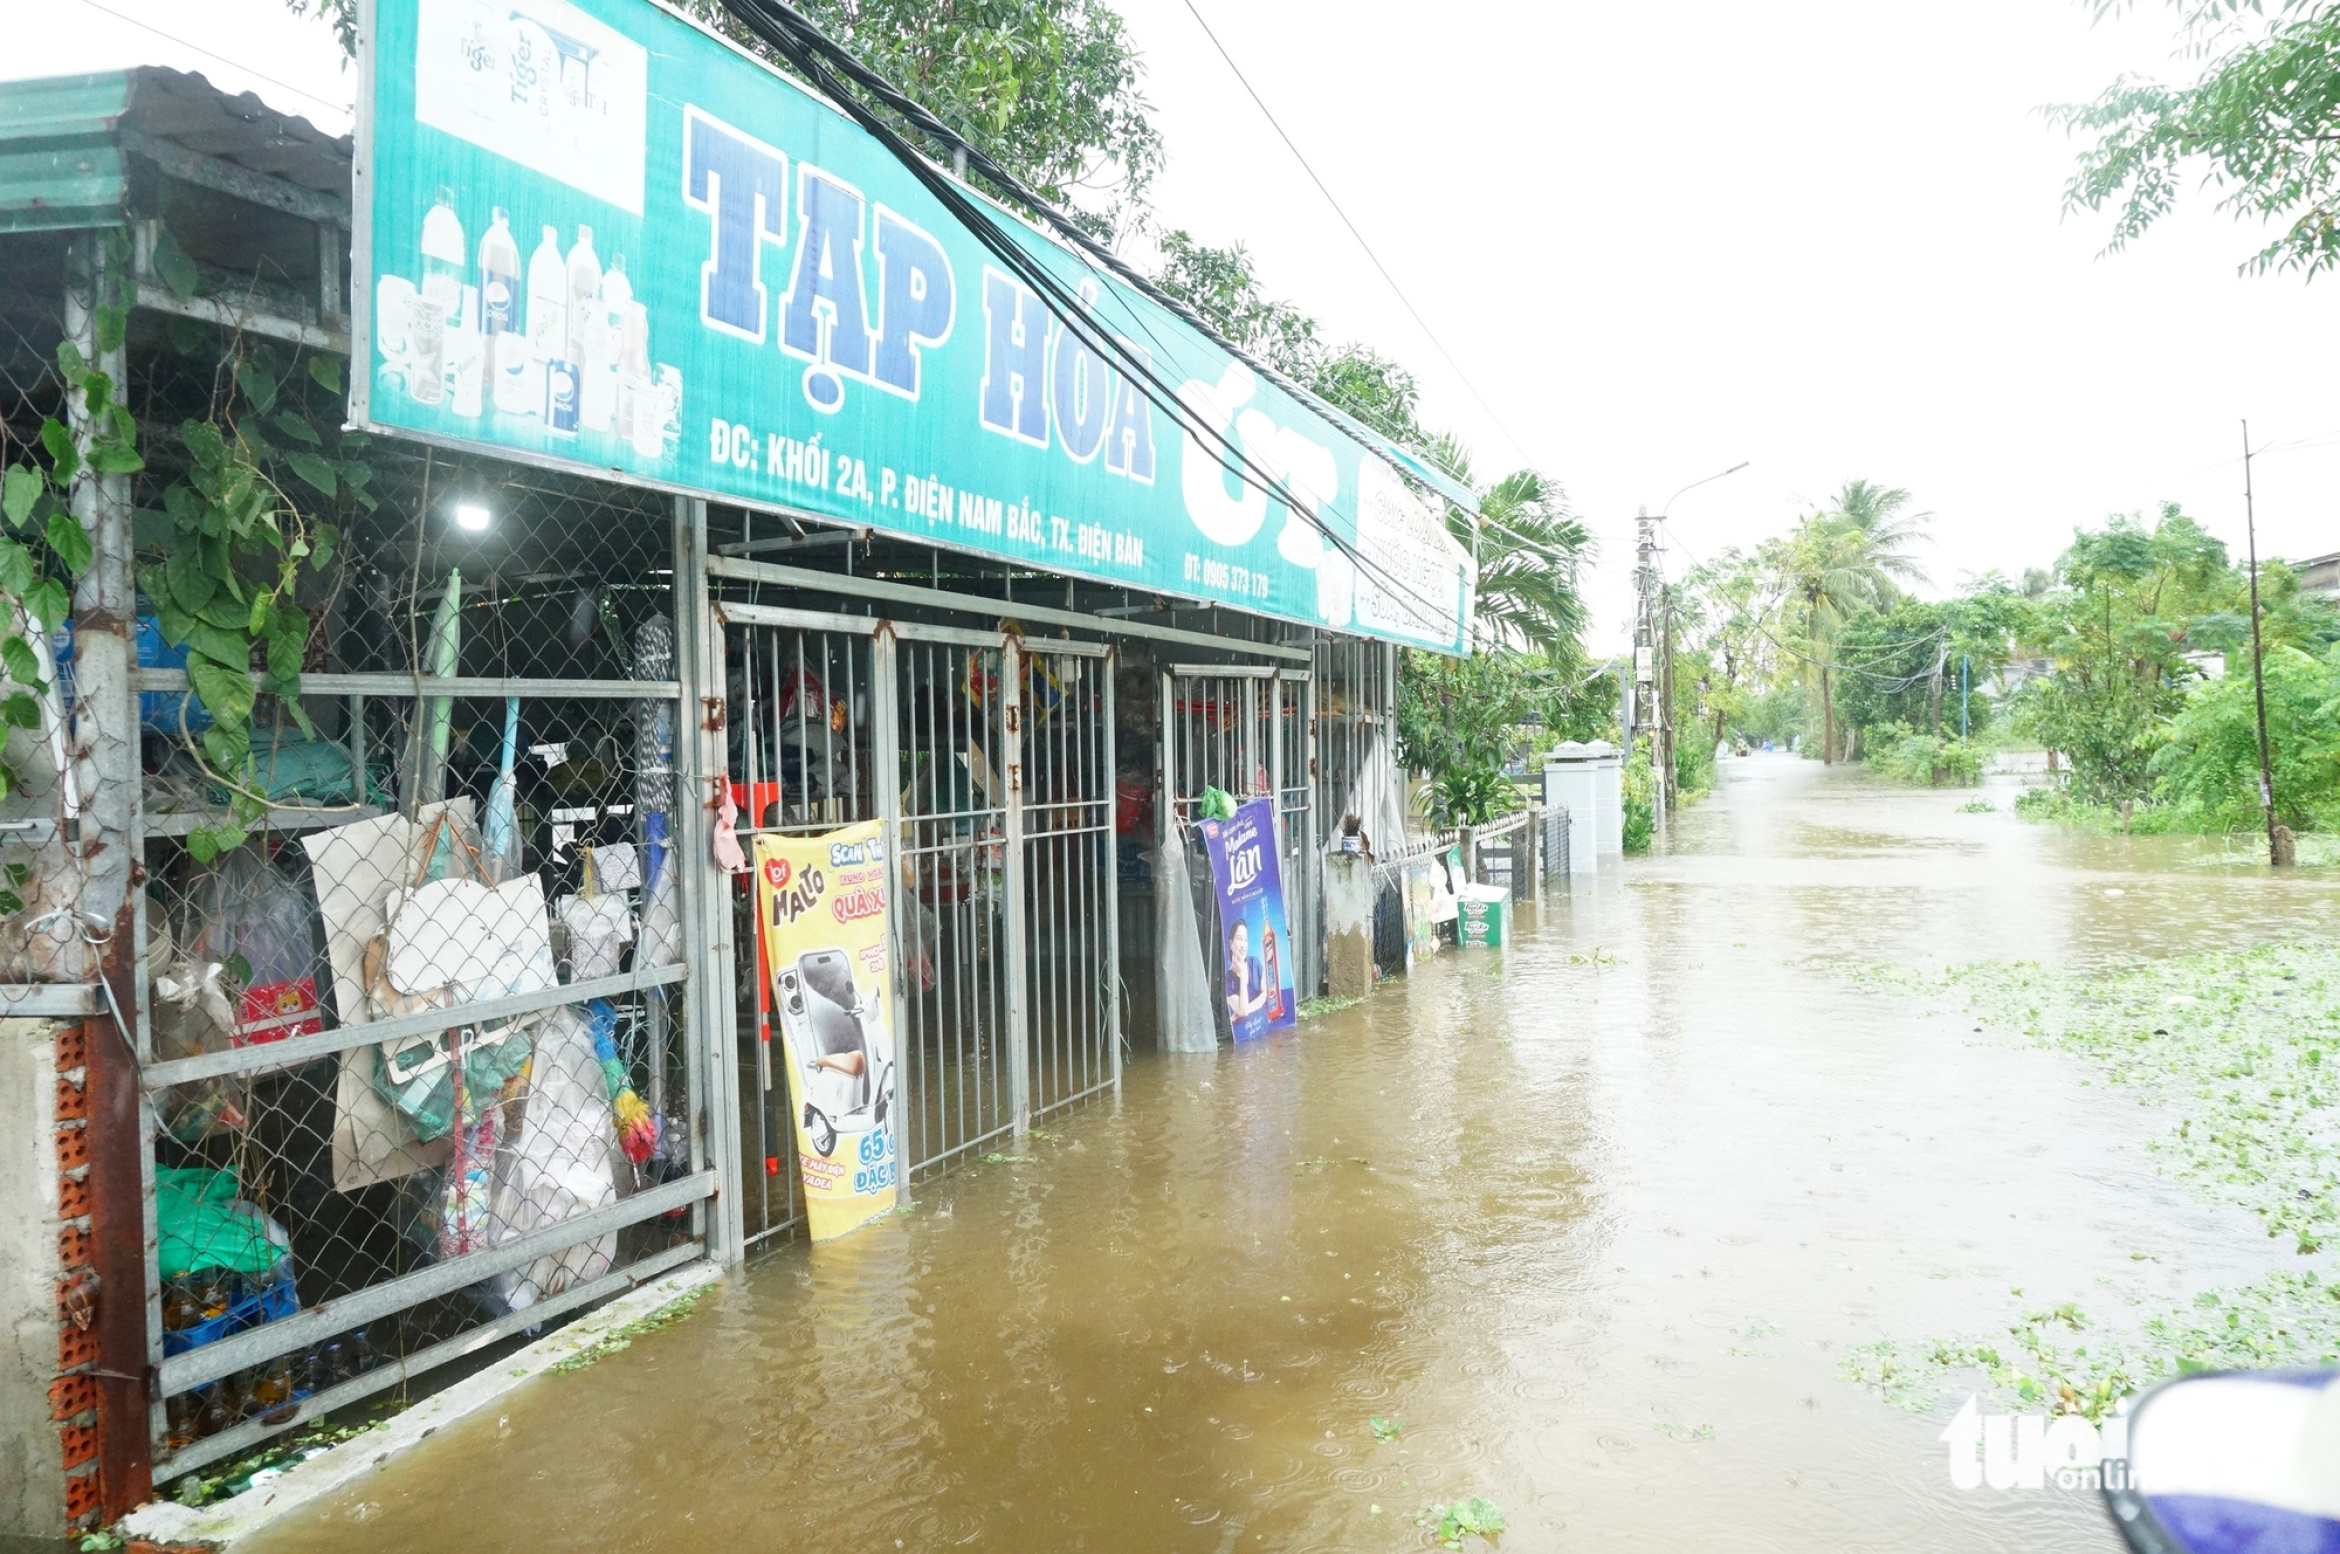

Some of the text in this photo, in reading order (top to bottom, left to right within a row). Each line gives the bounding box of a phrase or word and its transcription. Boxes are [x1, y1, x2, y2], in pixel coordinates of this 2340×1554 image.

[682, 102, 956, 415] TẠP
[710, 417, 759, 472] ĐC:
[767, 430, 830, 490] KHỐI
[837, 454, 874, 506] 2A,
[881, 466, 900, 510] P.
[904, 470, 955, 529] ĐIỆN
[957, 491, 1003, 537] NAM
[1006, 495, 1046, 548] BẮC,
[1050, 512, 1075, 549] TX.
[1077, 517, 1114, 568] ĐIỆN
[1184, 552, 1269, 599] ĐT: 0905 373 179
[831, 843, 866, 868] SCAN
[1225, 826, 1258, 861] Madame
[1227, 845, 1262, 896] Lân
[772, 863, 825, 927] MALTO
[832, 887, 869, 925] QUÀ
[859, 1127, 887, 1165] 65
[810, 1158, 827, 1174] MÁY
[854, 1162, 888, 1195] ĐẶC
